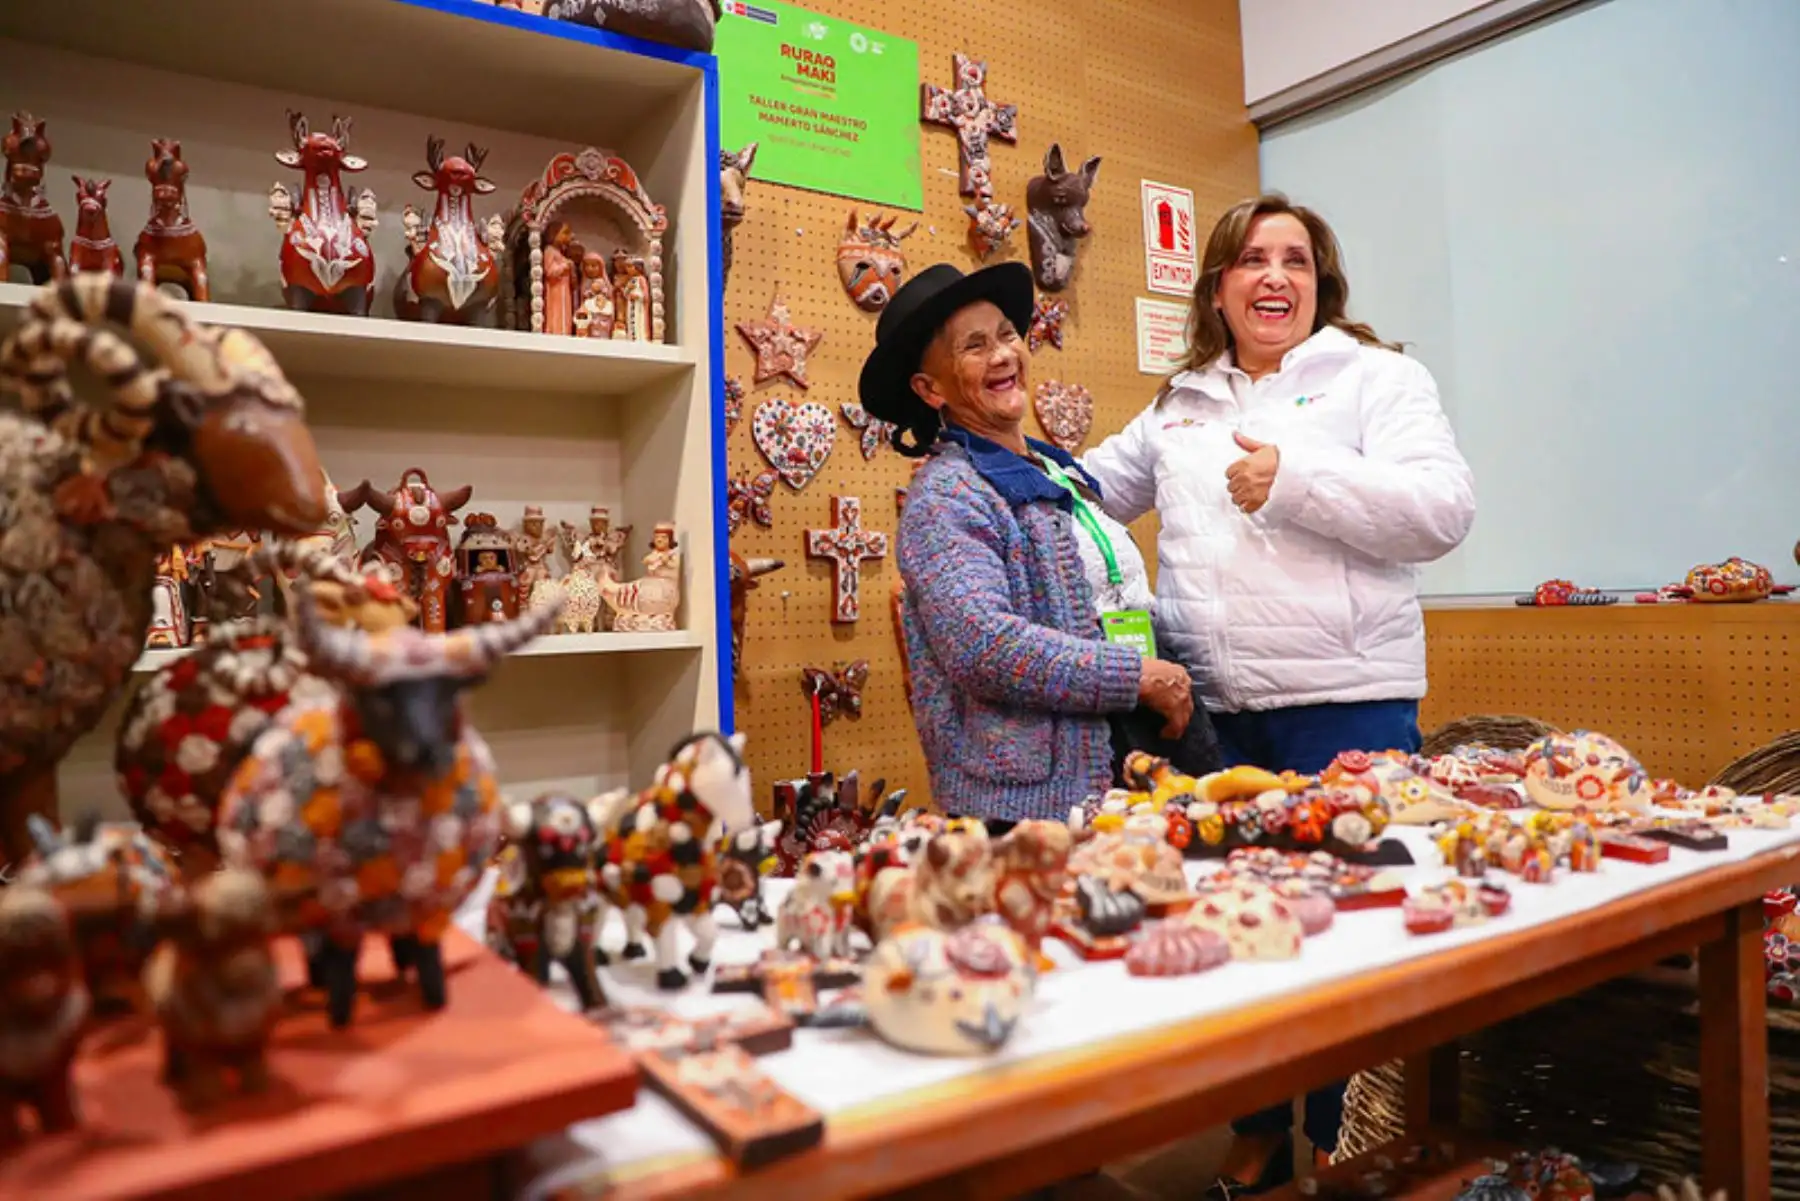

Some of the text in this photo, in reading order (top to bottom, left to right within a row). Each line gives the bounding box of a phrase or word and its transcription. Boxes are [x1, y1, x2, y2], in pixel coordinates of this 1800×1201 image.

[780, 43, 836, 69] RURAQ
[796, 63, 836, 84] MAKI
[748, 94, 868, 131] TALLER GRAN MAESTRO
[758, 111, 860, 143] MAMERTO SÁNCHEZ
